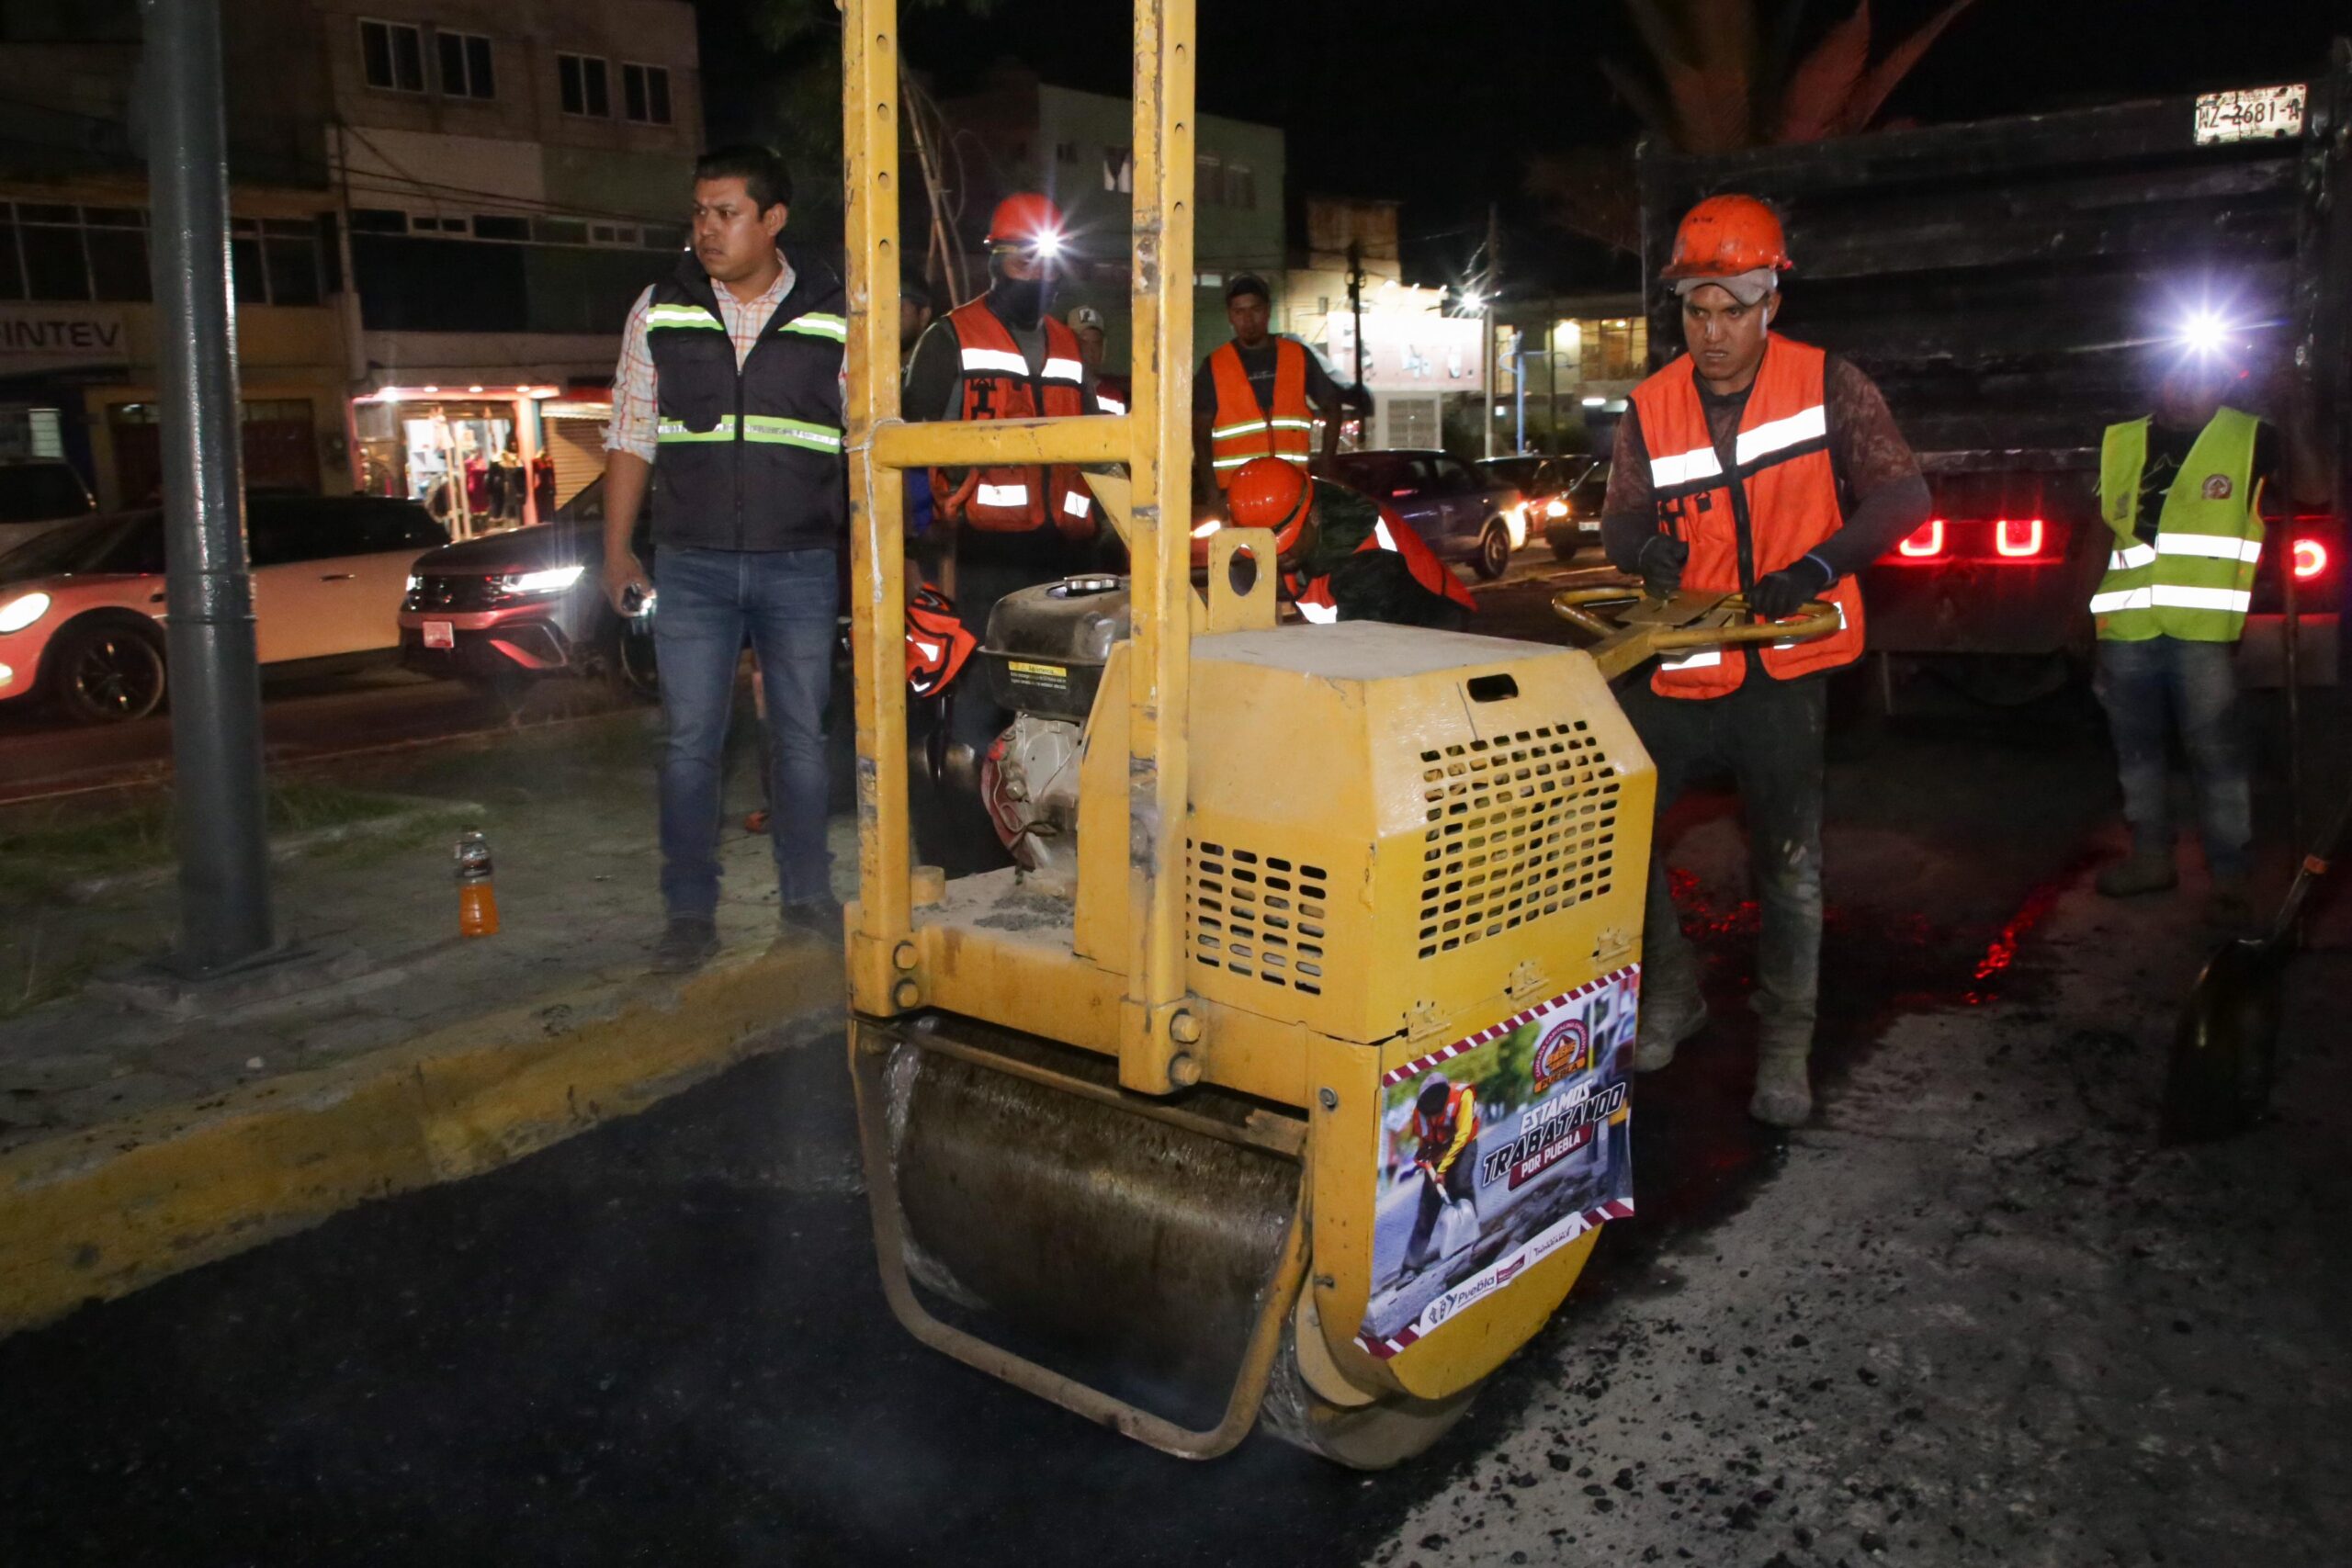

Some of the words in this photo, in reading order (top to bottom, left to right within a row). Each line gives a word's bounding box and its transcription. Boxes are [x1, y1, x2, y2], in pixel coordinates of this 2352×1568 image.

[0, 321, 120, 347] INTEV
[1520, 1078, 1593, 1136] ESTAMOS
[1482, 1082, 1626, 1188] TRABAJANDO
[1521, 1156, 1541, 1179] POR
[1544, 1131, 1581, 1165] PUEBLA
